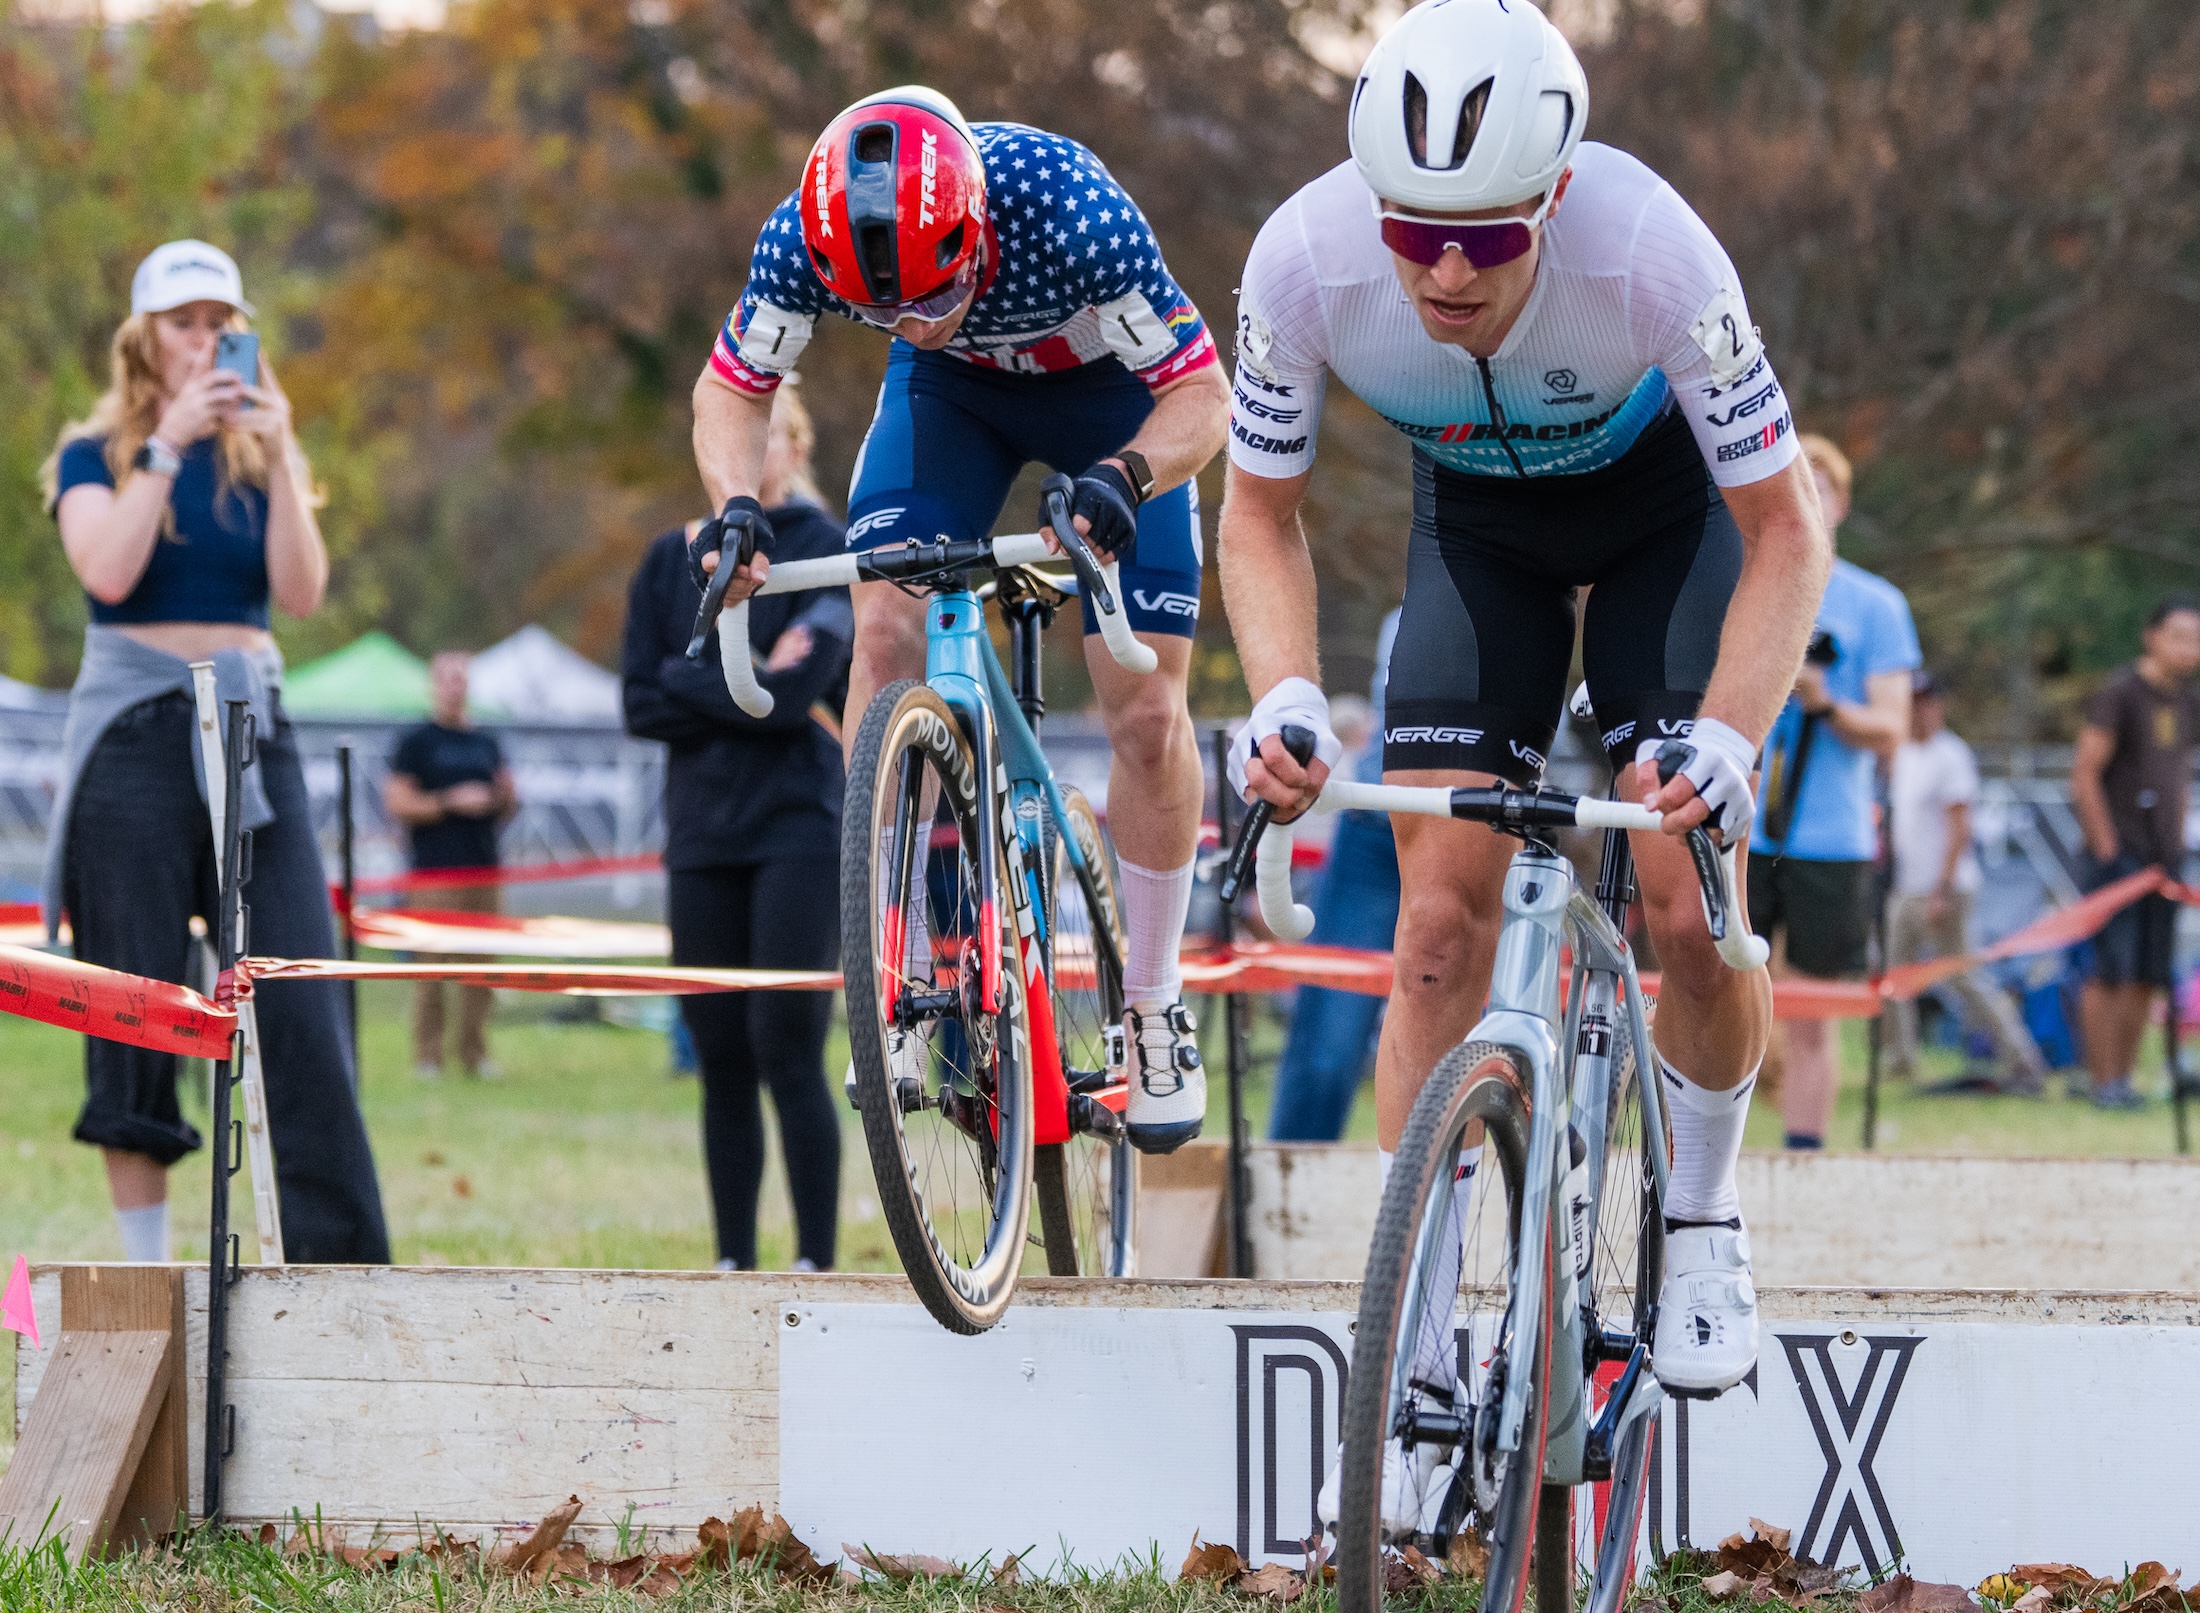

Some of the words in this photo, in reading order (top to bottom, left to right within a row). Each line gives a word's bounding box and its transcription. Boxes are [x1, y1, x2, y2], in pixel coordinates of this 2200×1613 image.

[815, 141, 834, 239] TREK
[918, 128, 938, 229] TREK
[770, 326, 787, 354] 1
[1117, 313, 1143, 346] 1
[1721, 313, 1744, 357] 2
[1234, 383, 1302, 424] RGE
[1230, 415, 1308, 455] RACING
[1717, 430, 1765, 454] COMP
[1717, 442, 1764, 463] EDGE
[916, 711, 979, 817] MONU
[58, 995, 88, 1015] MABRA
[1589, 1032, 1600, 1054] 1
